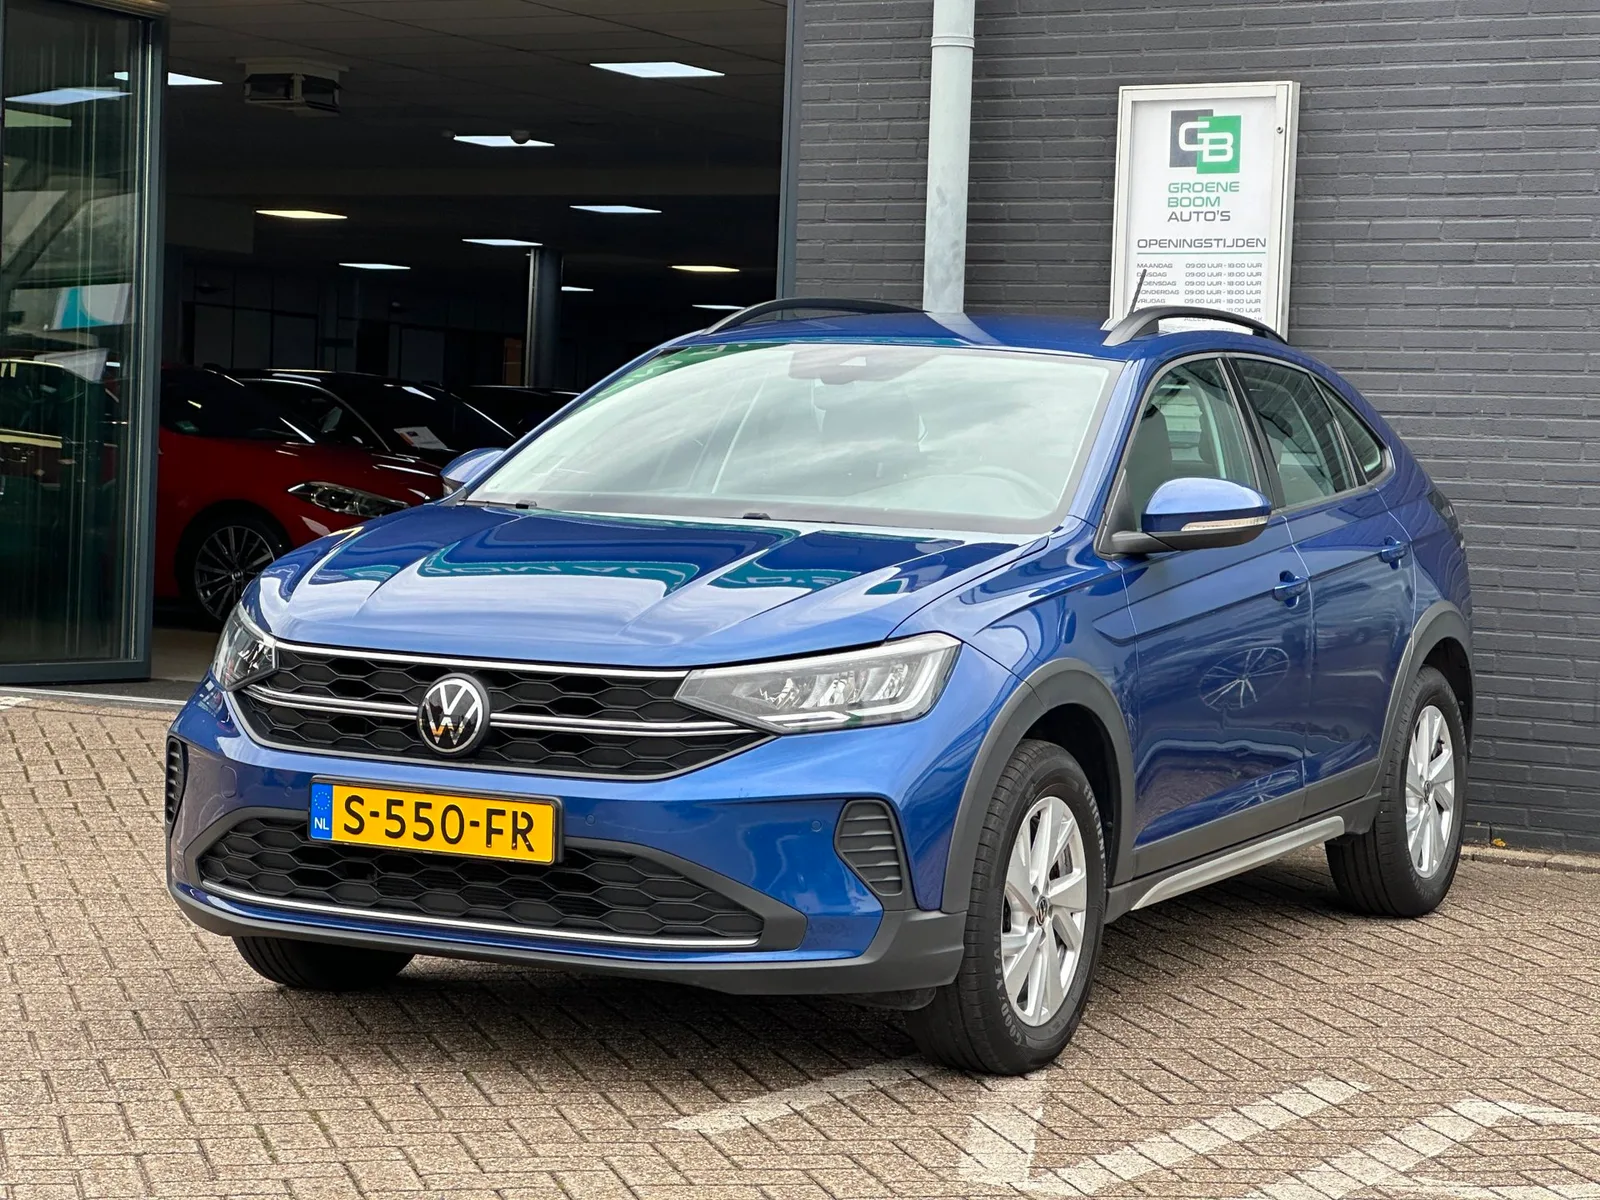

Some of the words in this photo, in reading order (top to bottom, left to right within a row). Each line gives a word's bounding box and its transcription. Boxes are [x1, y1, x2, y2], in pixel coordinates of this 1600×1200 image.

[1168, 181, 1240, 193] GROENE
[1167, 196, 1221, 208] BOOM
[1167, 210, 1231, 222] AUTO'S
[1137, 238, 1267, 249] OPENINGSTIJDEN
[314, 817, 329, 831] NL
[343, 794, 535, 852] S-550-FR
